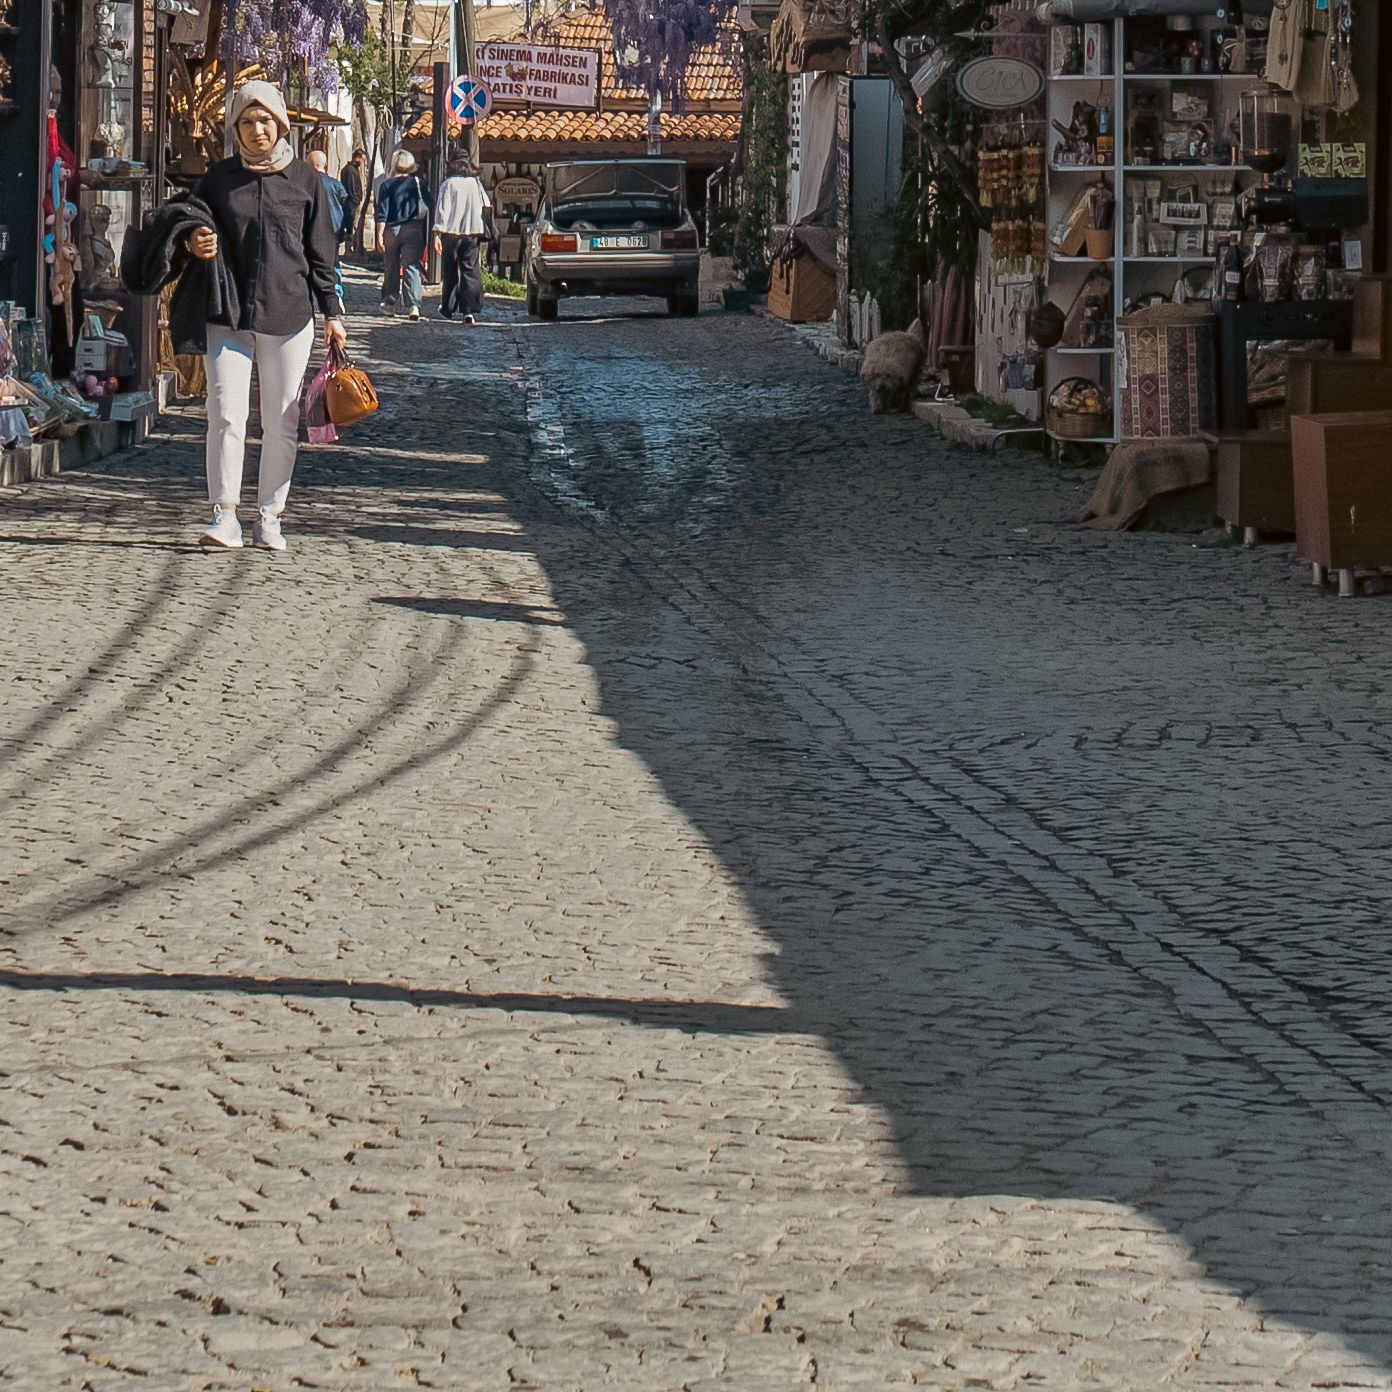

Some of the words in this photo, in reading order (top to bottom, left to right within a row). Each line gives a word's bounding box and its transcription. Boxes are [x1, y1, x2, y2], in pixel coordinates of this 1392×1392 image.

[488, 46, 533, 62] SİNEMA
[536, 51, 588, 69] MAHSEN
[528, 68, 590, 87] FABRİKASI
[488, 82, 524, 96] ATIŞ
[525, 85, 558, 99] YERİ
